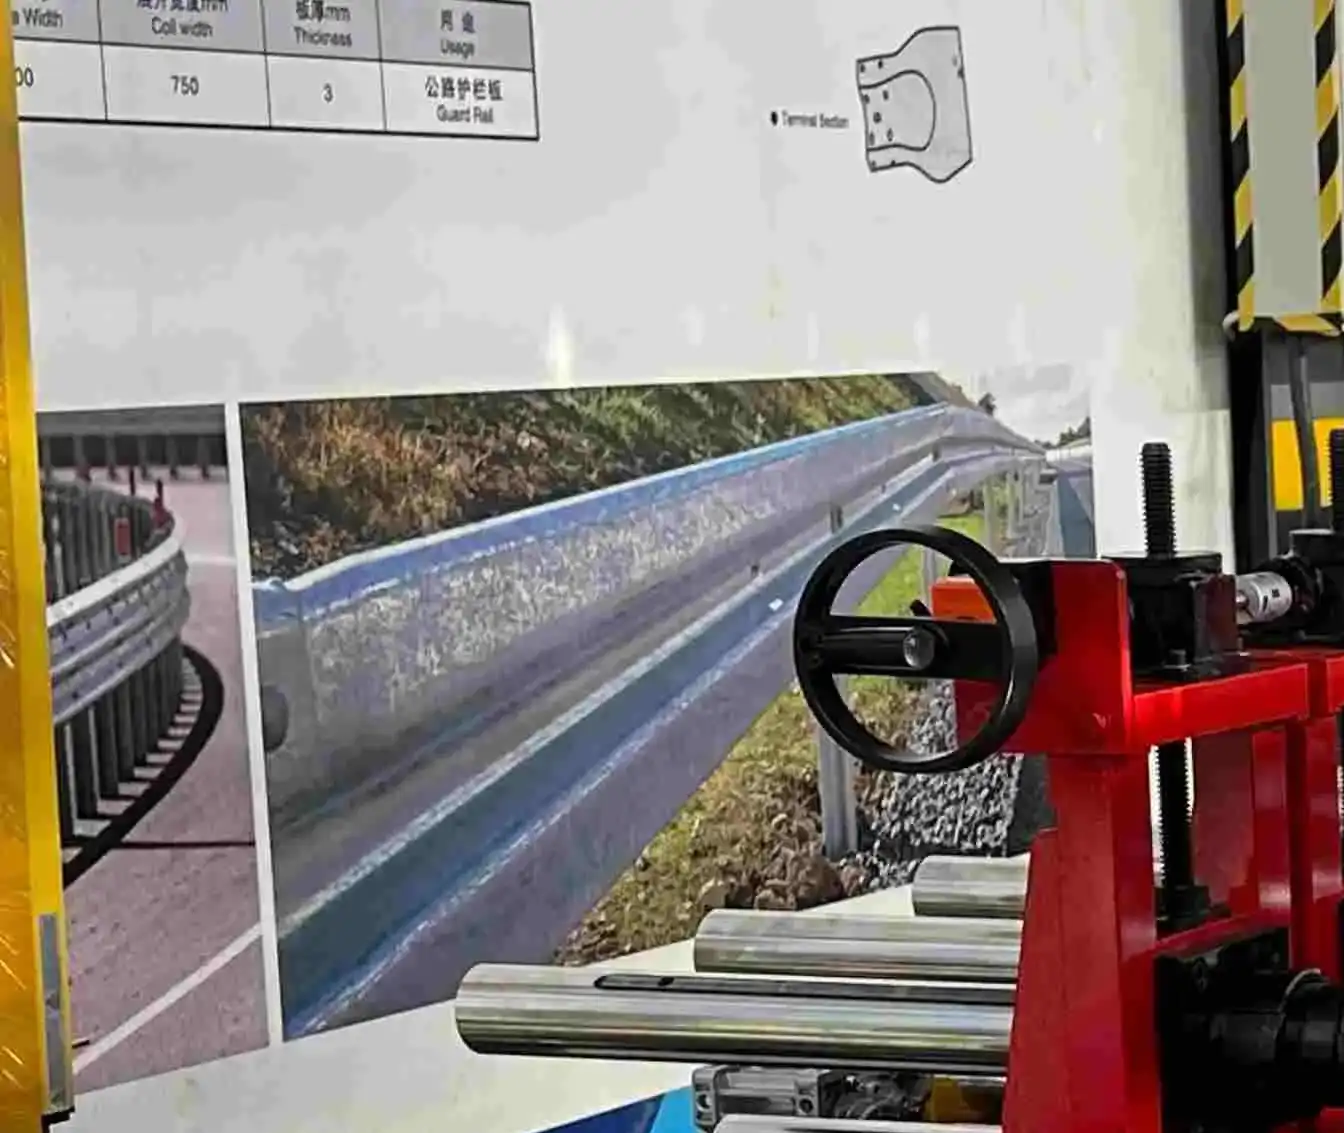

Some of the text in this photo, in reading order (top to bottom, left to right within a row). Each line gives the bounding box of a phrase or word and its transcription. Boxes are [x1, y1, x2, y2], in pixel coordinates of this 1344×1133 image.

[22, 8, 64, 28] Width
[293, 26, 353, 48] Thickness
[440, 39, 475, 59] Usage
[171, 75, 200, 95] 750
[323, 83, 335, 103] 3
[436, 103, 470, 123] Guard
